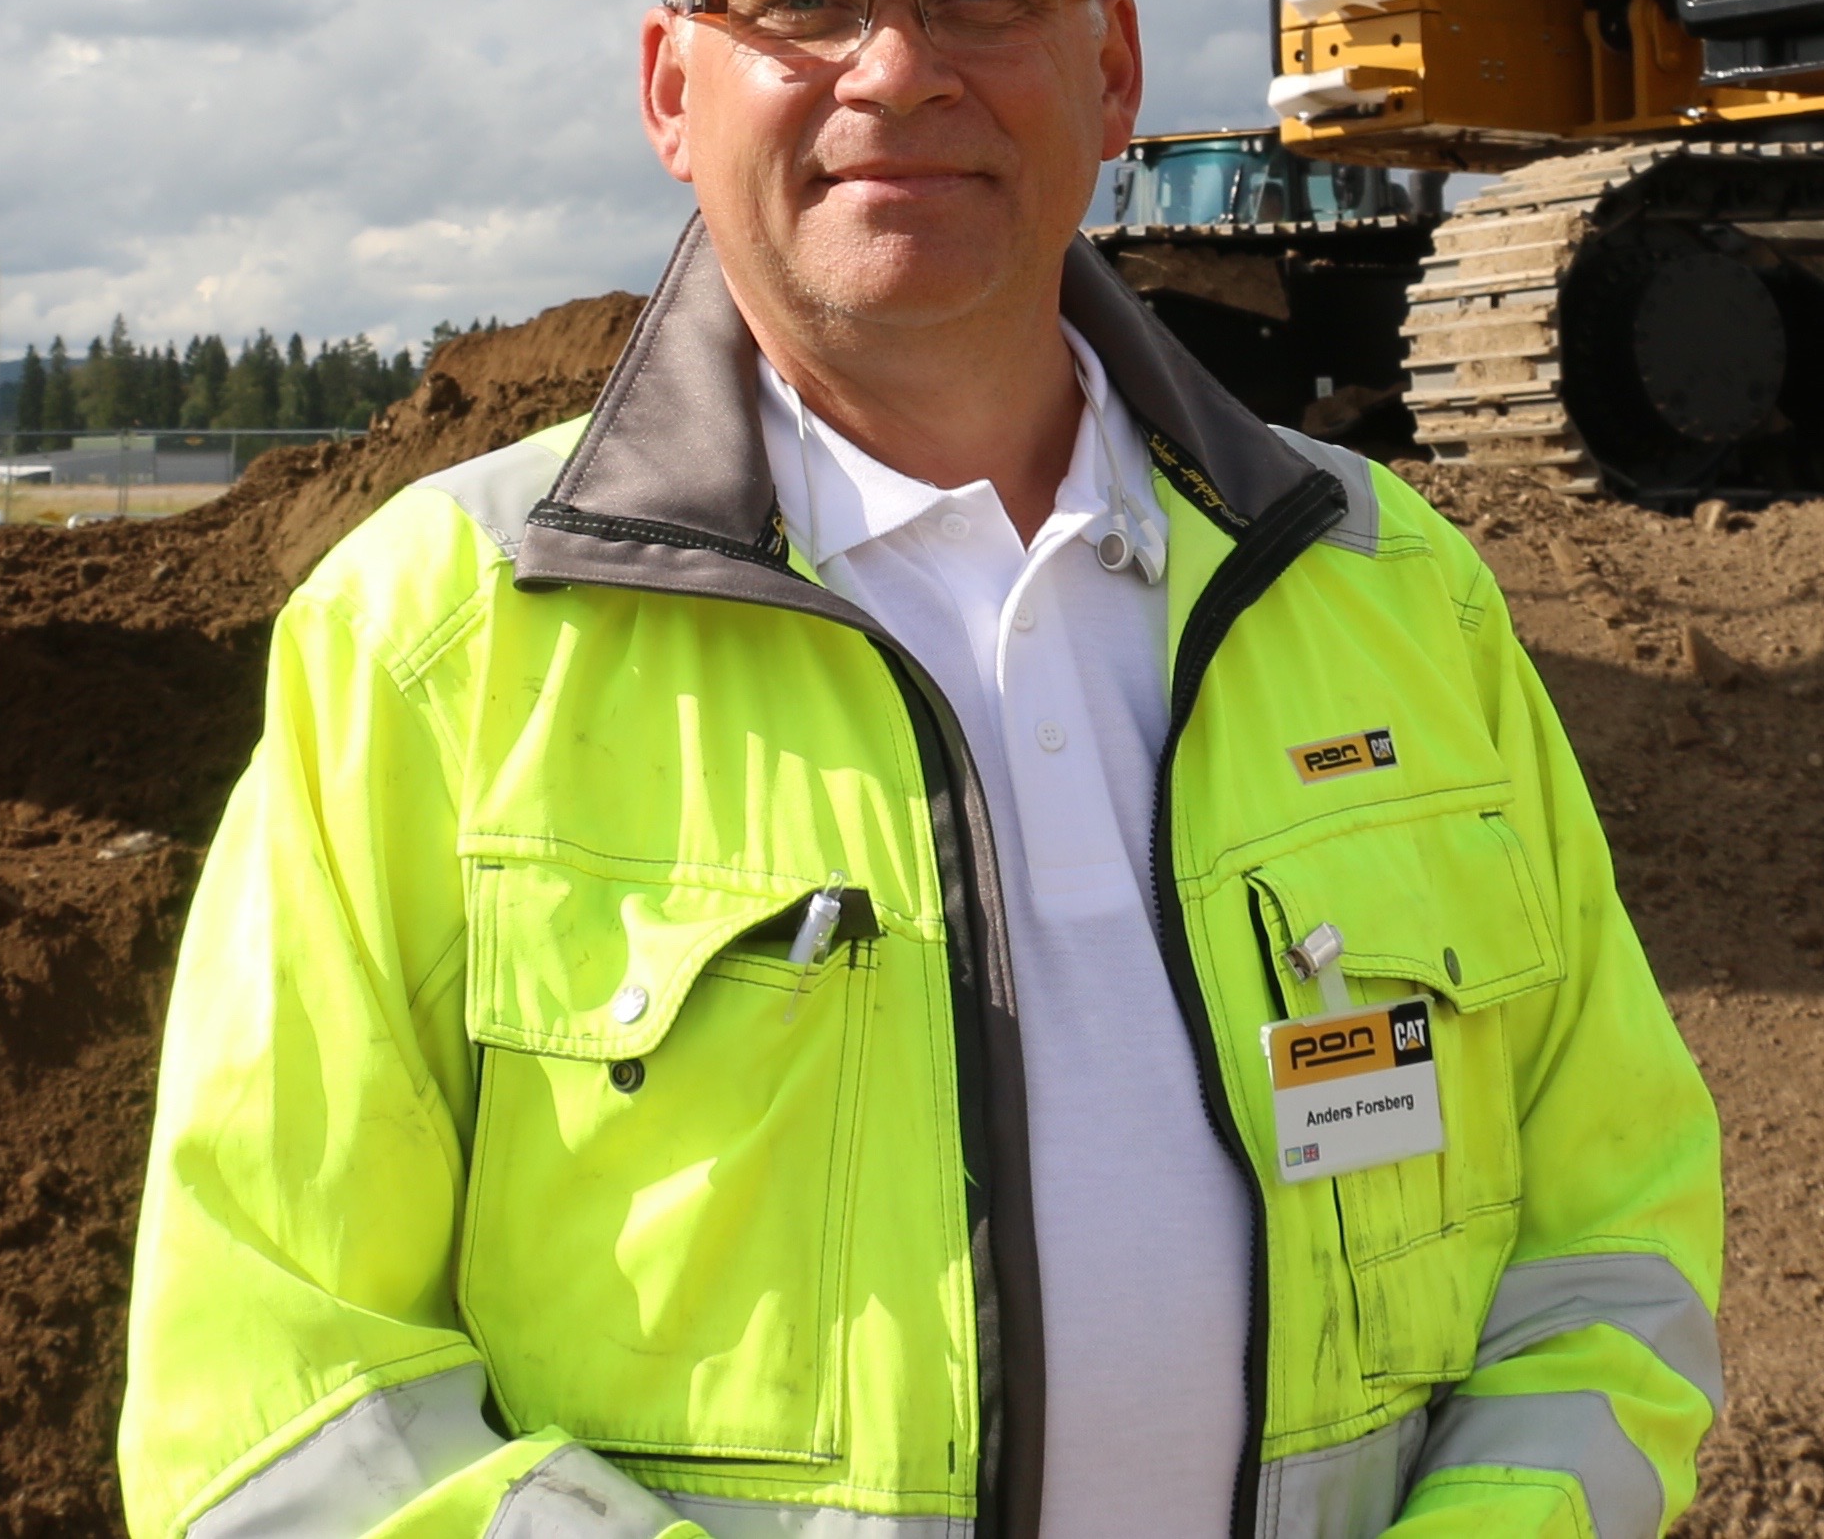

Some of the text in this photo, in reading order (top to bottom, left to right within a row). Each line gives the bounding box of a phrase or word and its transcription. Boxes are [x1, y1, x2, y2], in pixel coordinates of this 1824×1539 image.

[1370, 737, 1393, 759] CAT
[1394, 1018, 1426, 1051] CAT
[1306, 1093, 1415, 1127] Anders Forsberg
